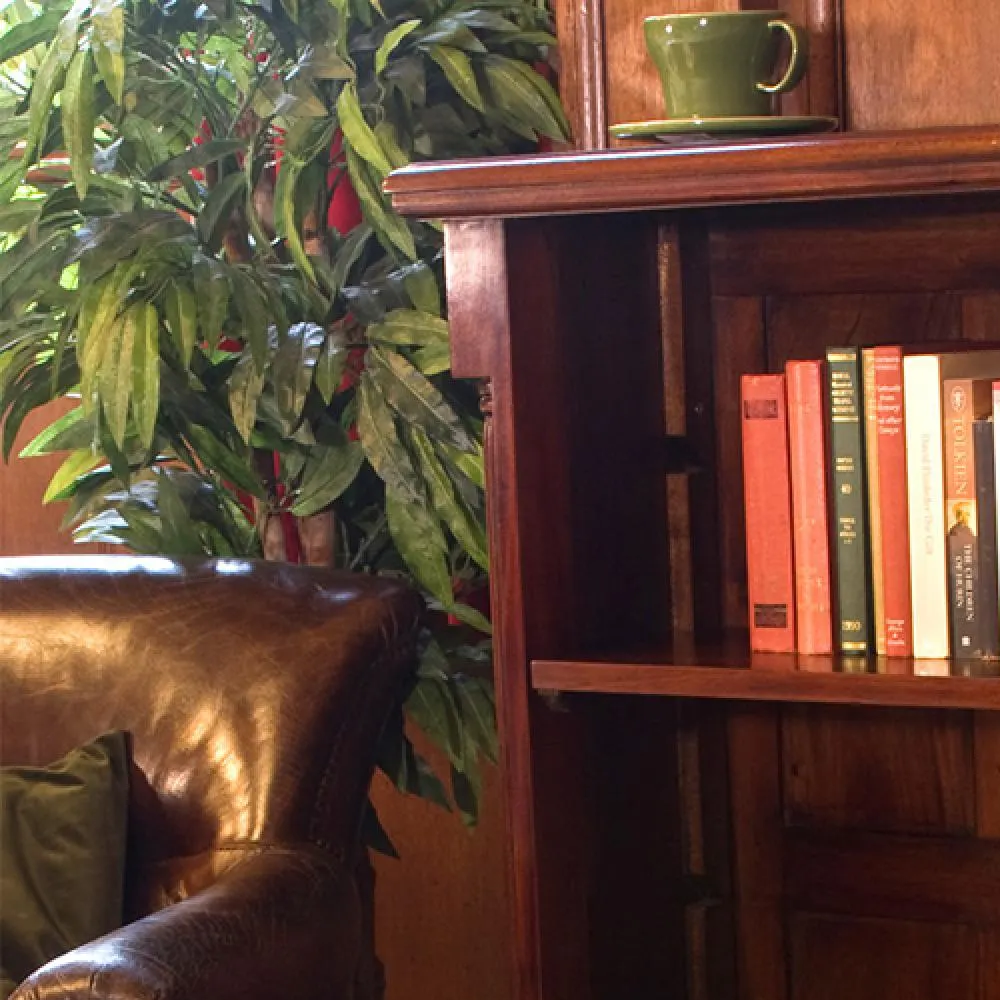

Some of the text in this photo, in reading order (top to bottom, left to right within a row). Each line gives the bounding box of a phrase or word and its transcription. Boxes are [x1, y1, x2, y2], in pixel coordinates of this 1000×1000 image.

[952, 417, 968, 495] TOLKIEN
[955, 556, 963, 570] OF
[965, 568, 974, 621] CHILDREN
